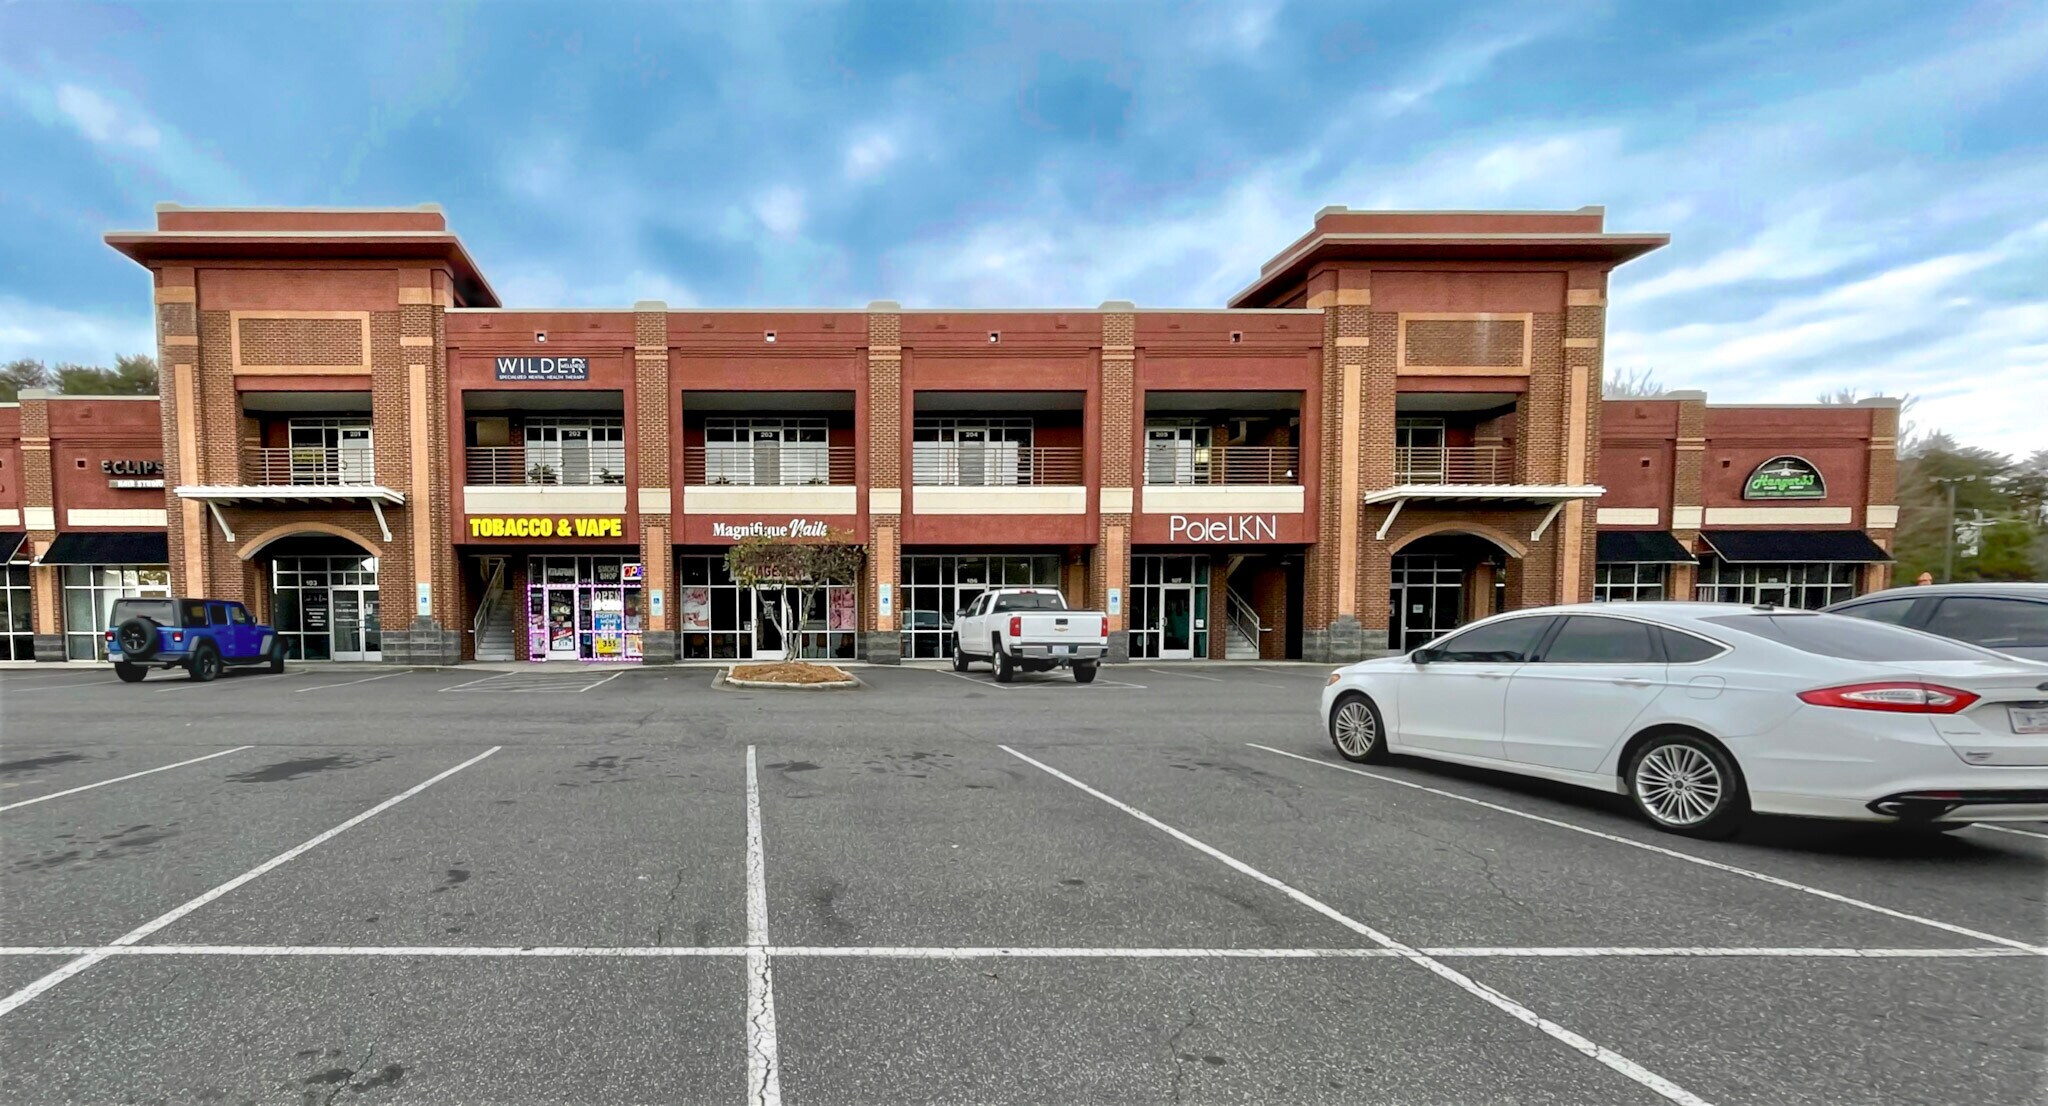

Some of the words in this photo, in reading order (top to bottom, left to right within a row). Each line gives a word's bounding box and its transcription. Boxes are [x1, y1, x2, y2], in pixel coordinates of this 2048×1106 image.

[497, 358, 584, 374] WILDER
[137, 479, 164, 488] STUDIO
[469, 518, 553, 537] TOBACCO
[556, 518, 572, 537] &
[574, 518, 622, 537] VAPE
[1169, 514, 1277, 542] PoleLKN
[597, 565, 619, 573] SMOKE
[599, 572, 617, 580] SHOP
[594, 590, 621, 601] OPEN
